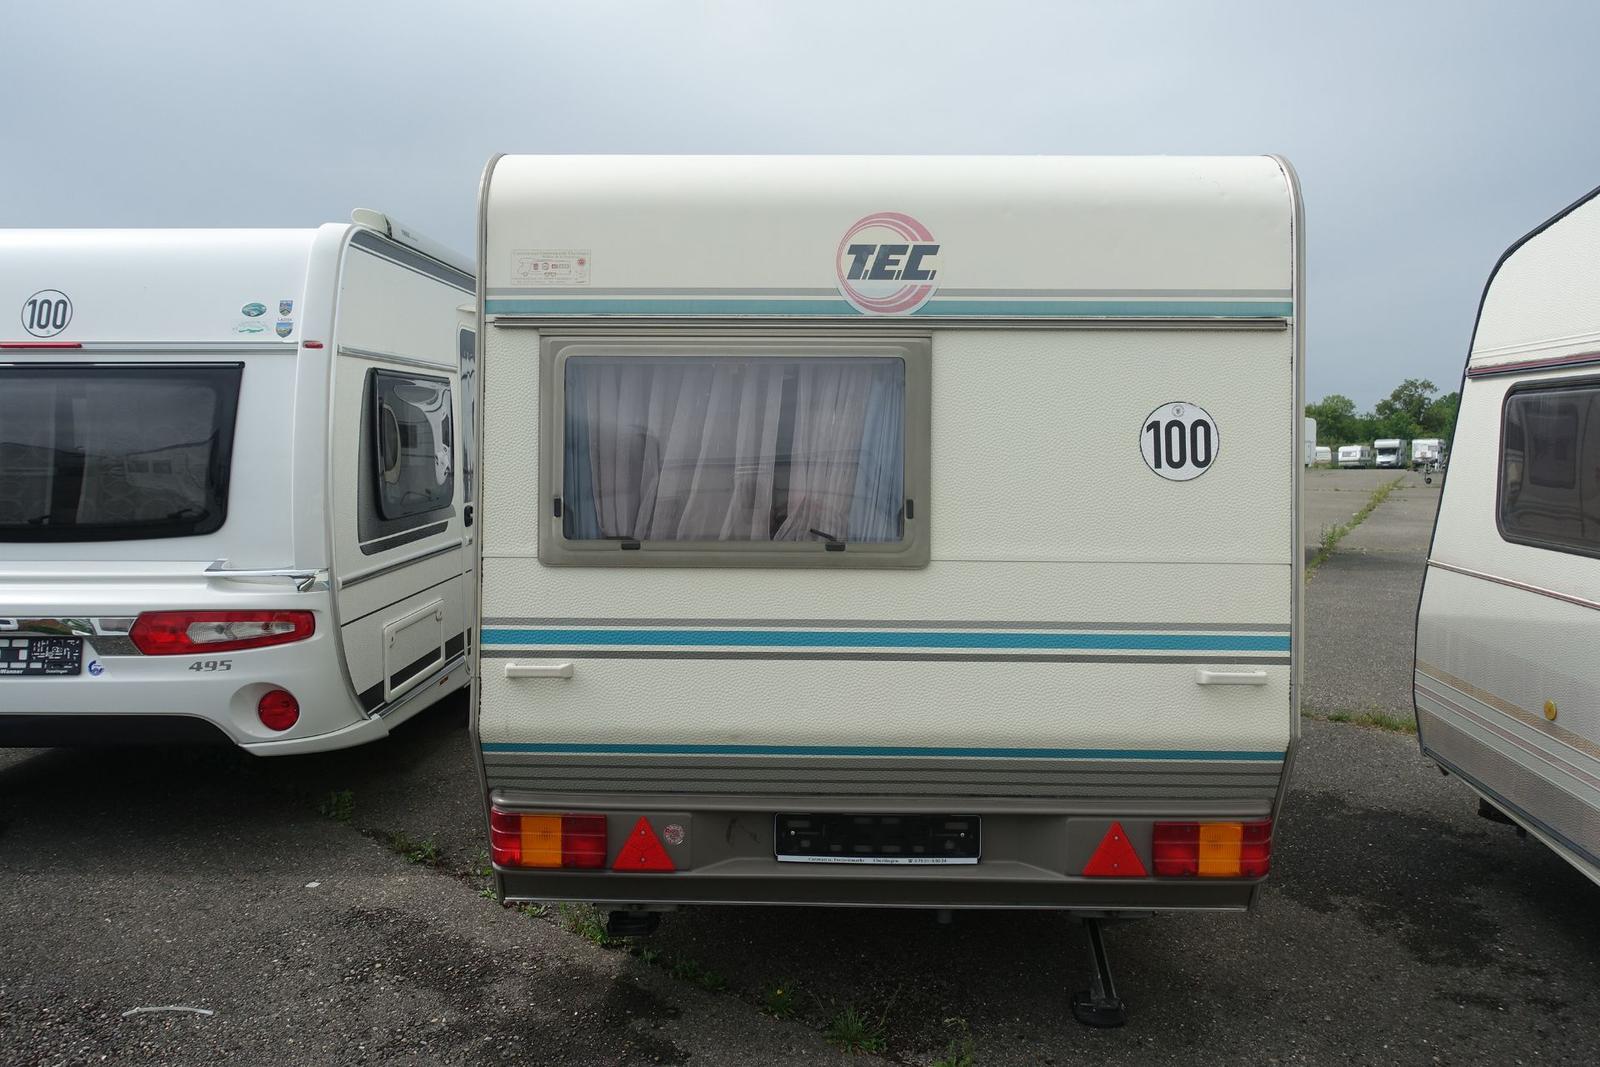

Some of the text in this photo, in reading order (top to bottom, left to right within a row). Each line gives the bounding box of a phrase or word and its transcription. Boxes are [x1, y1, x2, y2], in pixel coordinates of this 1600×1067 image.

[26, 298, 69, 330] 100
[1146, 418, 1212, 470] 100
[188, 659, 233, 672] 495
